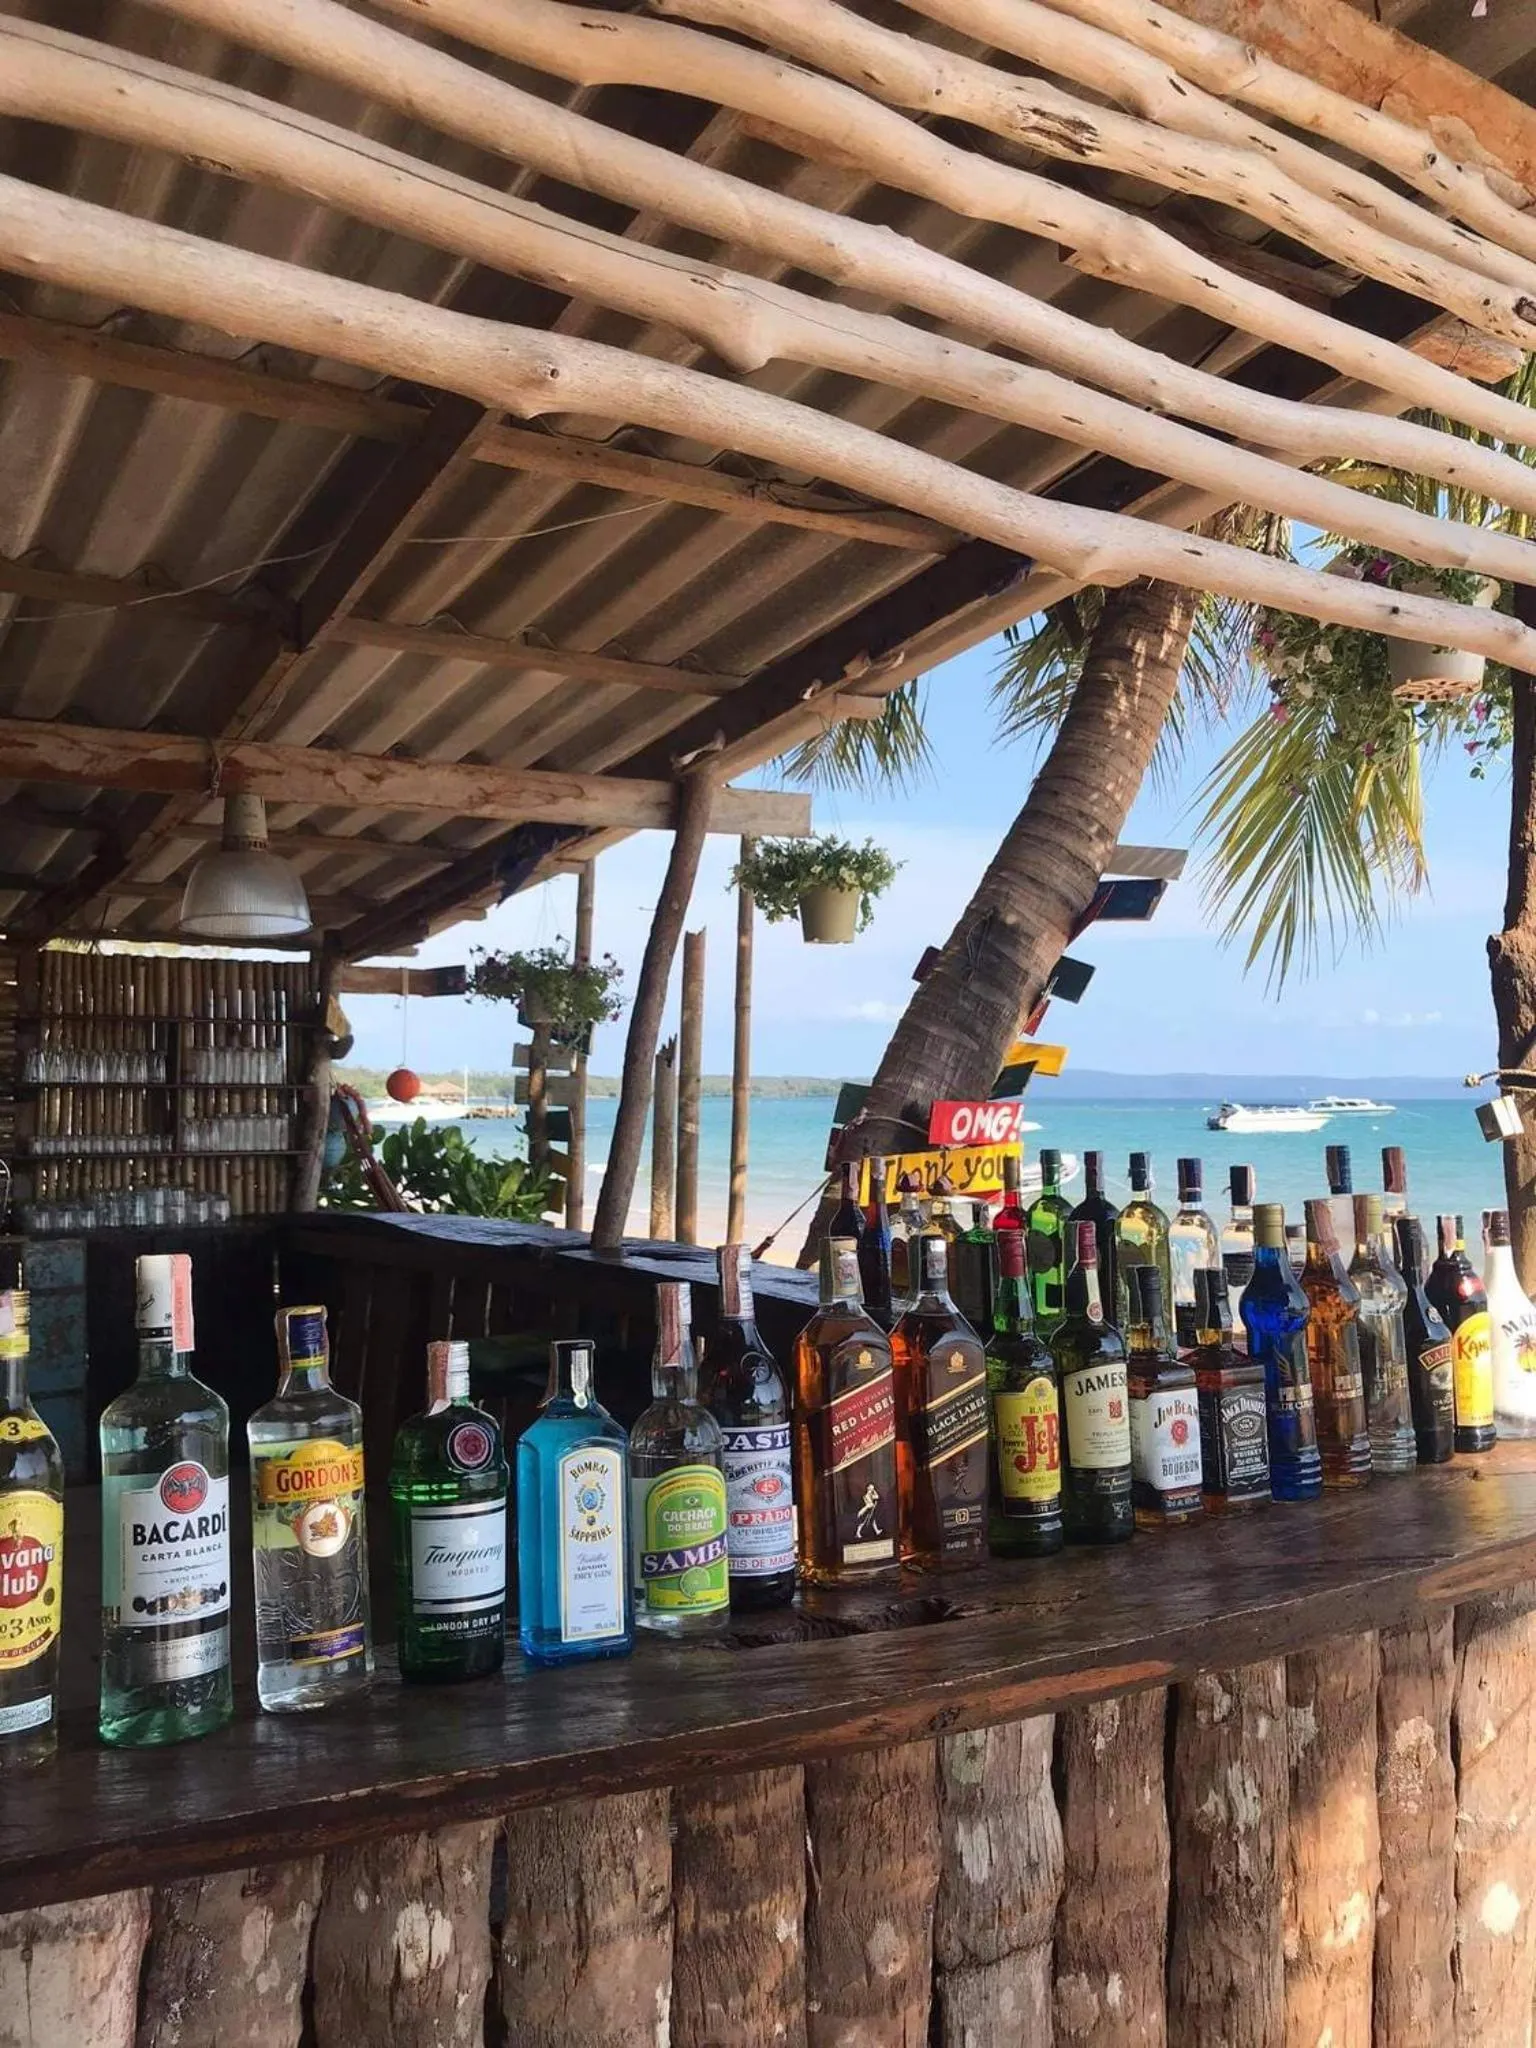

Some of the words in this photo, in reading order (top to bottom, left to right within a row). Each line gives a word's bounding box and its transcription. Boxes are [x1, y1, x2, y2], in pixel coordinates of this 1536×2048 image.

[951, 1104, 1024, 1141] OMG!
[1075, 1372, 1127, 1396] JAMES
[832, 1417, 857, 1436] RED
[860, 1395, 895, 1420] LABEL
[926, 1412, 957, 1436] BLACK
[959, 1396, 986, 1418] LABEL
[8, 1422, 20, 1435] 3
[276, 1459, 360, 1493] GORDON'S
[1162, 1459, 1200, 1477] BOURBON
[132, 1504, 226, 1546] BACARDÍ
[569, 1524, 613, 1543] SAPPHIRE
[142, 1551, 181, 1562] CARTA
[185, 1543, 222, 1557] BLANCA
[729, 1559, 747, 1570] TIS
[0, 1572, 39, 1596] lub
